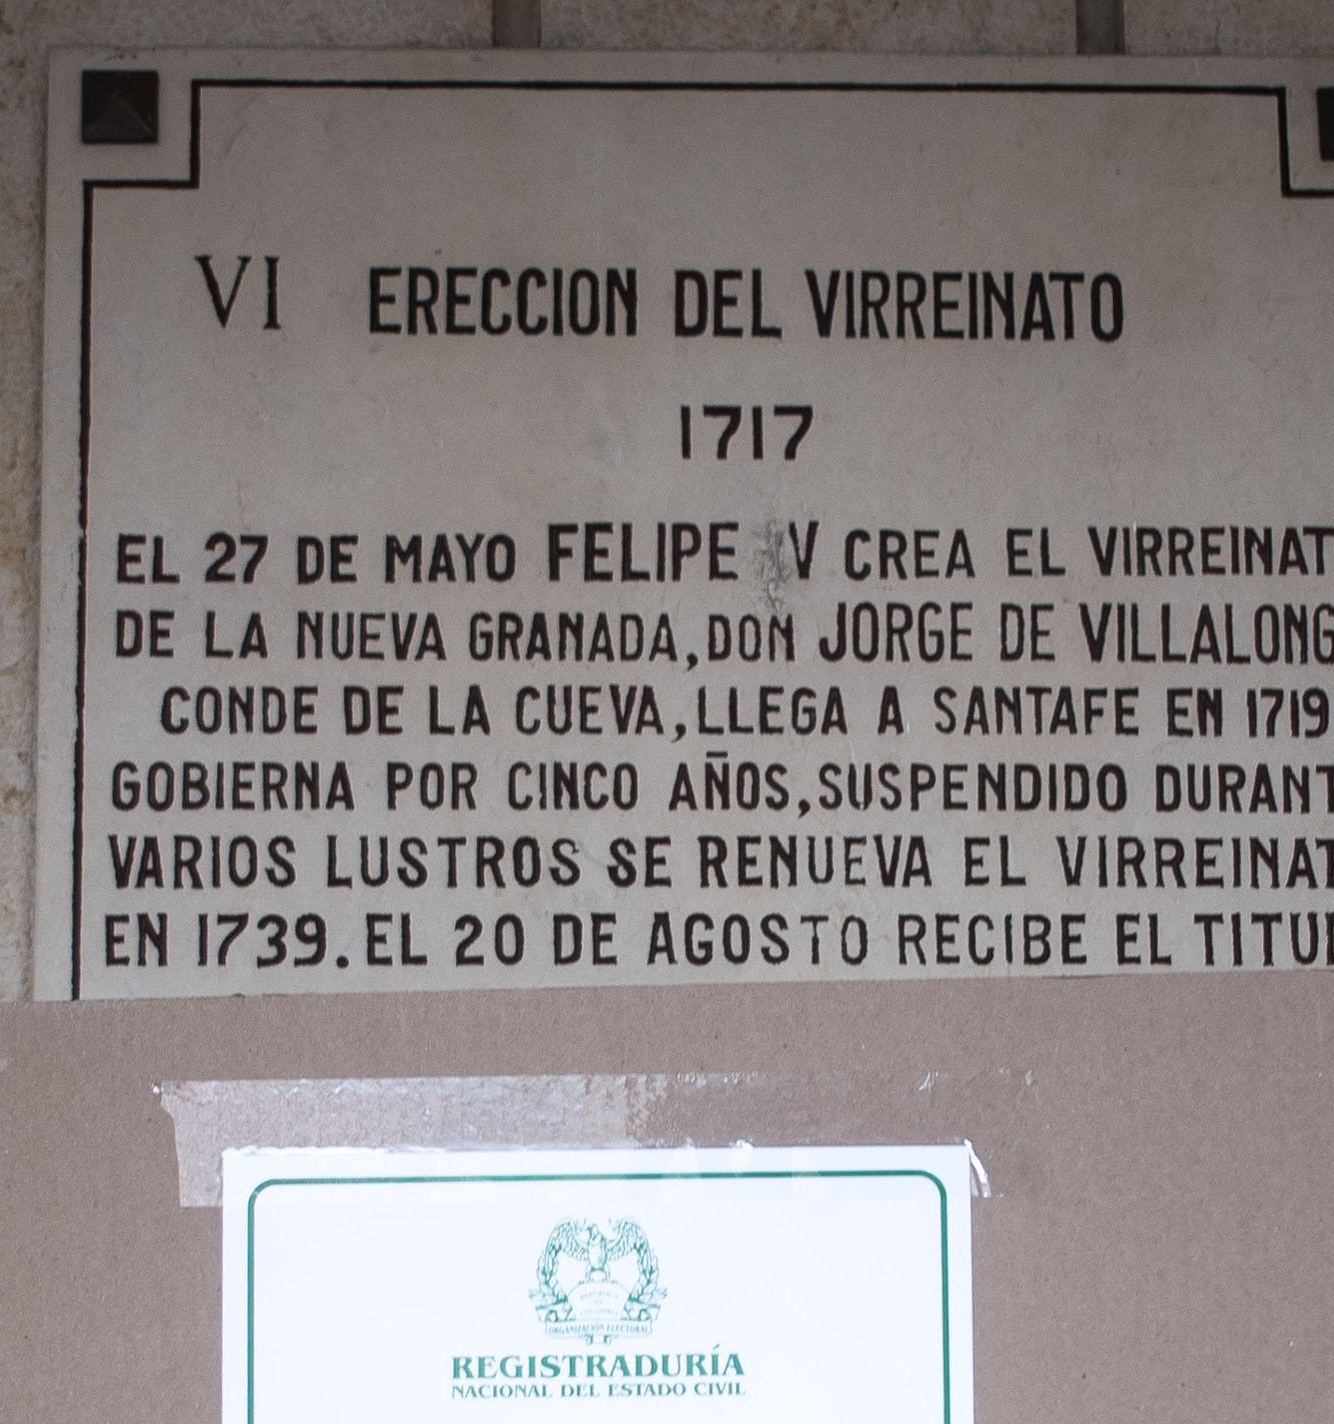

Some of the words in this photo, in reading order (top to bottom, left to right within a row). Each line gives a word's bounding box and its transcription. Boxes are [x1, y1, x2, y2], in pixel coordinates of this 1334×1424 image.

[195, 254, 280, 330] VI
[369, 267, 637, 336] ERECCION
[675, 269, 782, 339] DEL
[805, 269, 1124, 343] VIRREINATO
[681, 405, 813, 460] 1717
[117, 533, 179, 584] EL
[205, 532, 268, 584] 27
[297, 535, 358, 585] DE
[385, 533, 515, 583] MAYO
[548, 522, 739, 582] FELIPE
[789, 521, 819, 580] V
[845, 529, 975, 581] CREA
[1007, 527, 1066, 576] EL
[116, 610, 174, 657] DE
[205, 611, 267, 658] LA
[297, 611, 446, 661] NUEVA
[708, 614, 794, 662] DON
[819, 602, 972, 663] JORGE
[1000, 603, 1055, 661] DE
[160, 686, 318, 734] CONDE
[343, 686, 404, 735] DE
[429, 685, 490, 735] LA
[698, 686, 847, 735] LLEGA
[878, 686, 904, 735] A
[934, 686, 1139, 736] SANTAFE
[1167, 688, 1223, 737] EN
[112, 761, 354, 812] GOBIERNA
[387, 762, 477, 810] POR
[508, 761, 637, 811] CINCO
[819, 763, 1127, 812] SUSPENDIDO
[108, 835, 295, 889] VARIOS
[327, 835, 580, 888] LUSTROS
[607, 836, 671, 888] SE
[697, 834, 932, 889] RENUEVA
[964, 835, 1026, 886] EL
[105, 913, 167, 967] EN
[366, 913, 427, 966] EL
[455, 914, 524, 966] 20
[553, 912, 617, 965] DE
[647, 912, 868, 966] AGOSTO
[898, 913, 1087, 965] RECIBE
[1116, 914, 1172, 965] EL
[452, 1343, 745, 1379] REGISTRADURÍA
[452, 1384, 553, 1399] NACIONAL
[560, 1383, 600, 1398] DEL
[608, 1382, 686, 1398] ESTADO
[693, 1382, 746, 1396] CIVIL
